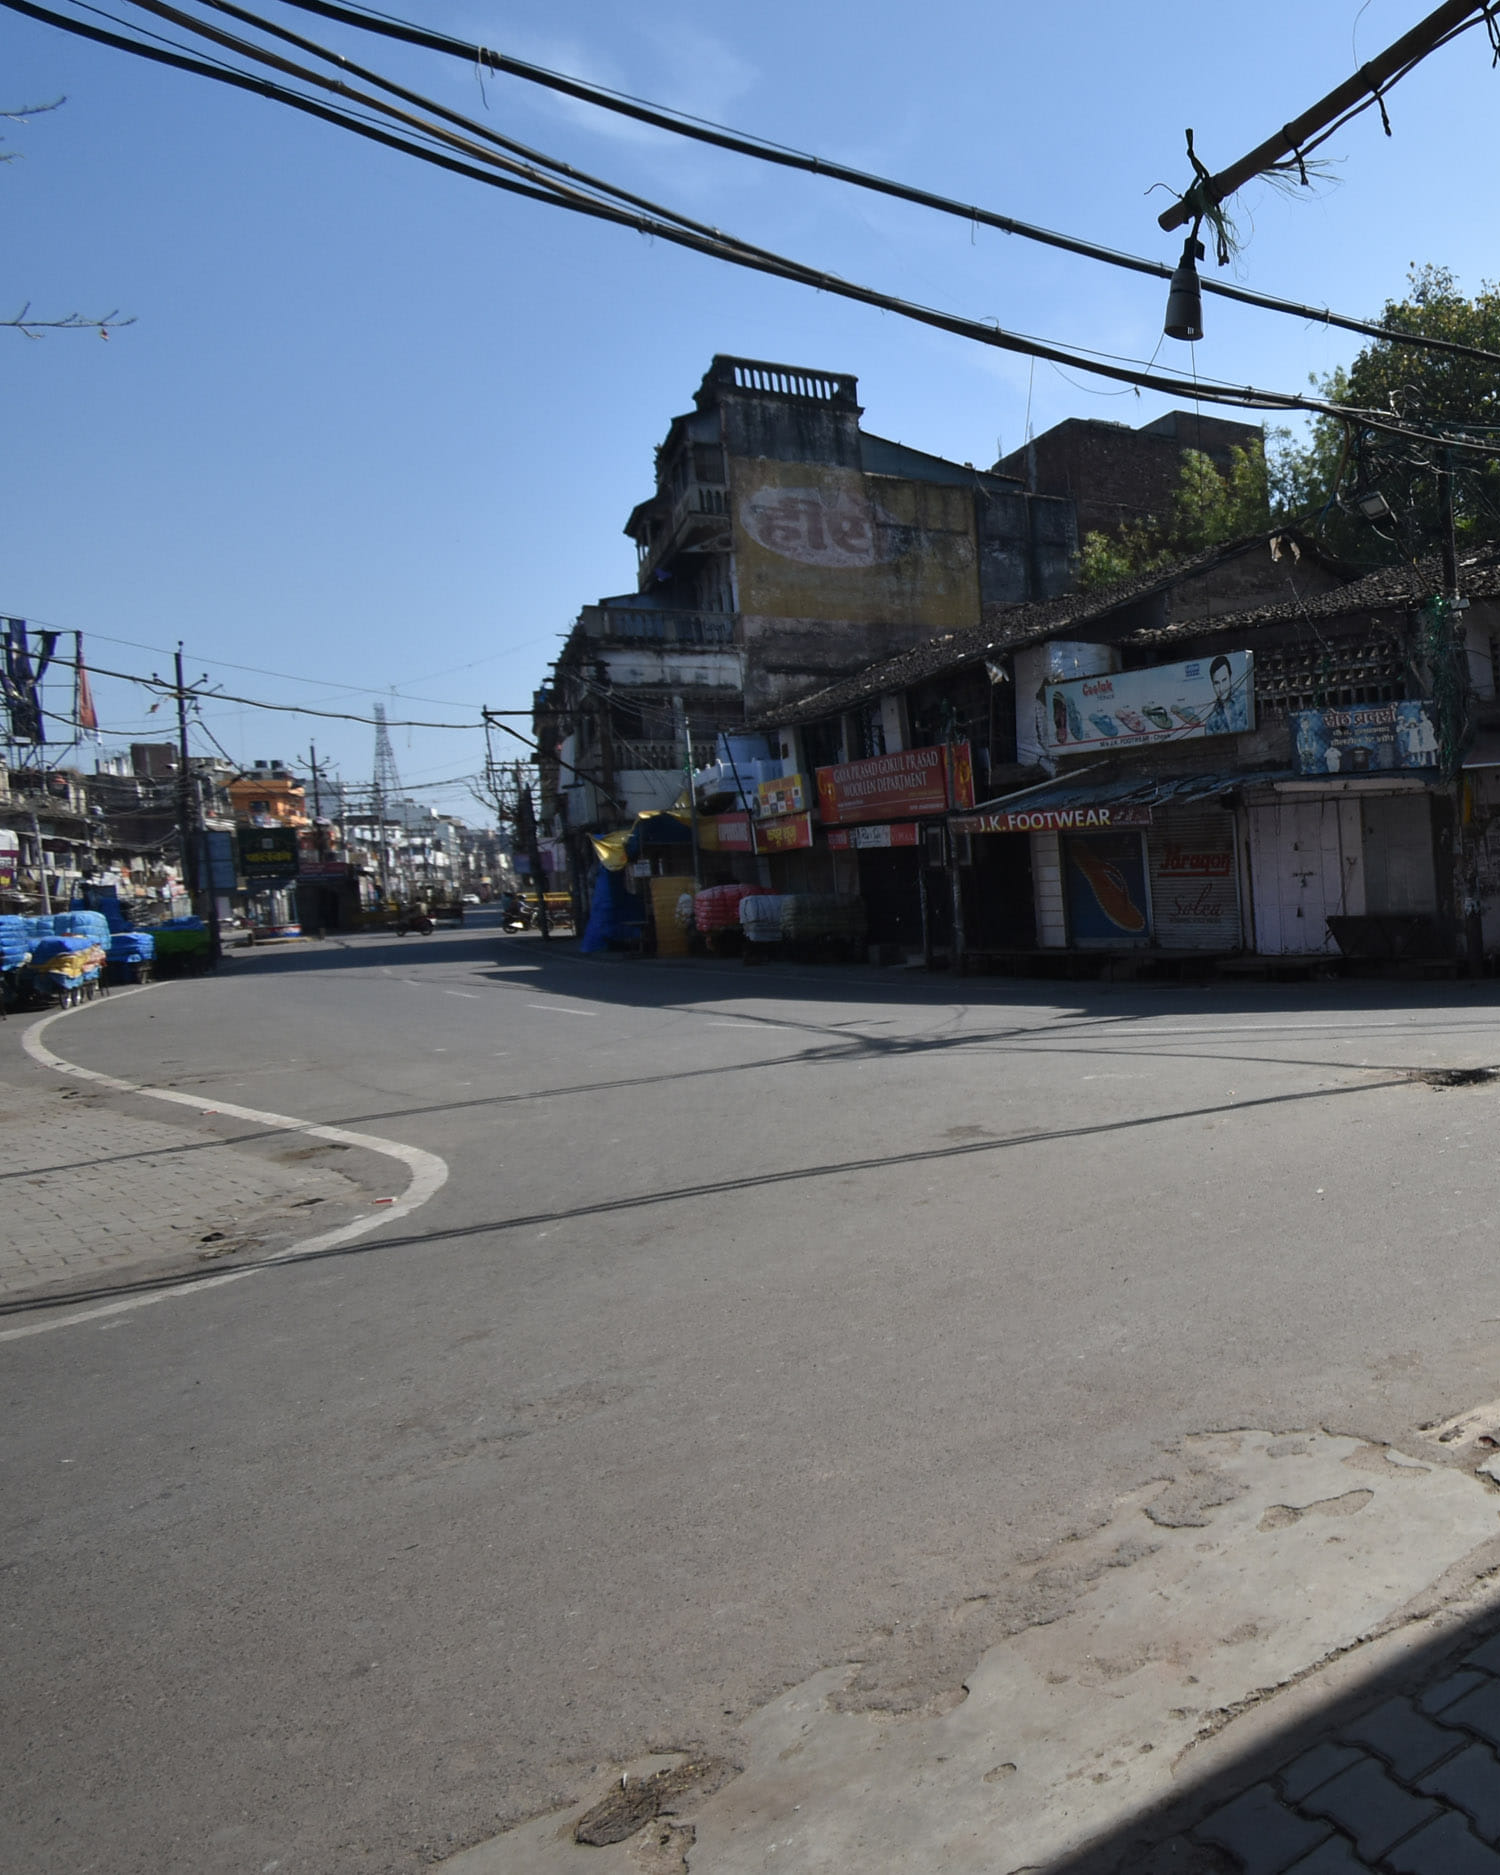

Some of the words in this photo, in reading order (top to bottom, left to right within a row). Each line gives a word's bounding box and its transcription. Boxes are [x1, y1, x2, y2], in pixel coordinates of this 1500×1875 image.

[905, 750, 938, 771] PRASAD
[877, 770, 928, 793] DEPARTMENT
[979, 815, 1006, 832] J.K.
[1007, 808, 1112, 831] FOOTWEAR
